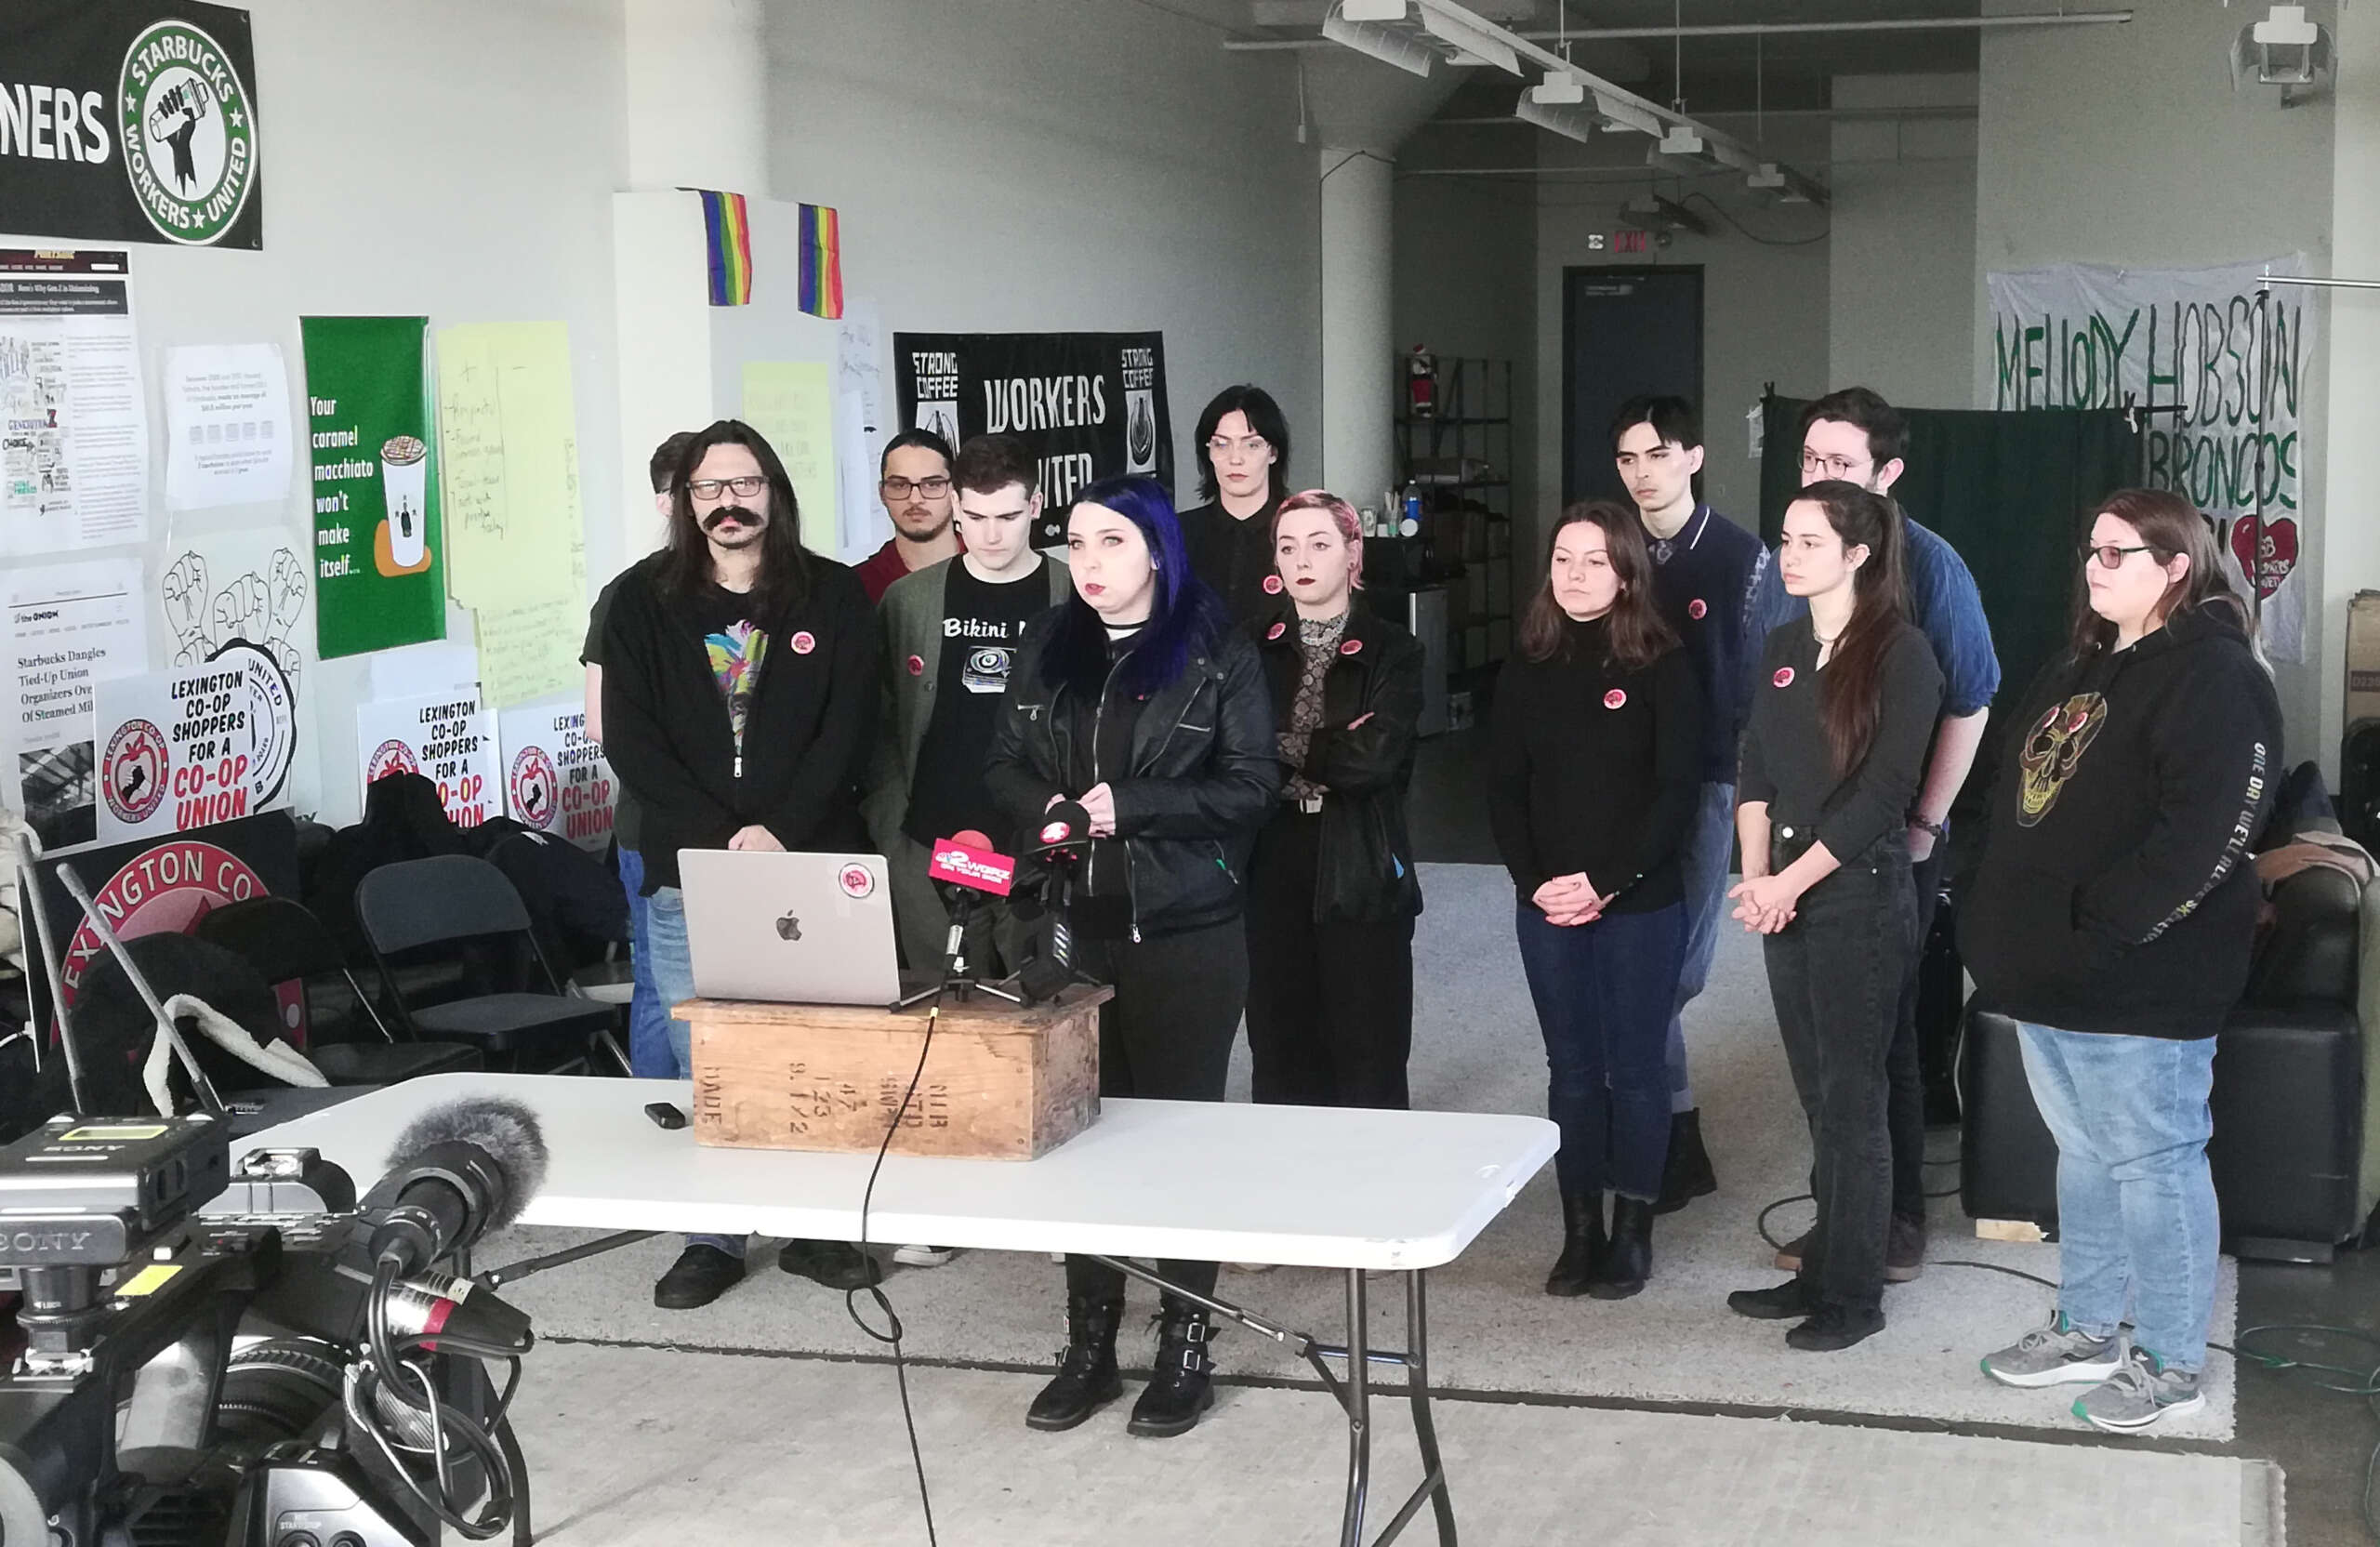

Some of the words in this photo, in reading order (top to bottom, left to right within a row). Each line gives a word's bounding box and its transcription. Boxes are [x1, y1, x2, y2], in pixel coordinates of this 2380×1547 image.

[132, 35, 233, 102] STARBUCKS
[0, 82, 110, 164] NERS
[126, 123, 190, 229] WORKERS
[205, 137, 245, 221] UNITED
[912, 352, 958, 375] STRONG
[1121, 348, 1153, 368] STRONG
[2148, 295, 2301, 429] HOBSON
[917, 377, 959, 399] COFFEE
[1122, 367, 1154, 389] COFFEE
[311, 397, 337, 416] Your
[984, 375, 1106, 434] WORKERS
[312, 425, 358, 449] caramel
[314, 456, 373, 482] macchiato
[1038, 453, 1092, 509] ITED
[2148, 430, 2297, 509] BRONCOS
[316, 491, 349, 513] won't
[319, 523, 350, 546] make
[33, 609, 59, 622] ONION
[942, 617, 1008, 639] Bikini
[18, 653, 66, 668] Starbucks
[68, 647, 106, 663] Dangles
[19, 672, 58, 688] Tied-Up
[60, 668, 89, 680] Union
[171, 670, 243, 699] LEXINGTON
[248, 658, 283, 707] UNITED
[20, 687, 73, 707] Organizers
[74, 684, 93, 697] Ove
[186, 693, 231, 718] CO-OP
[22, 710, 33, 723] Of
[35, 705, 76, 721] Steamed
[78, 699, 93, 714] Mil
[419, 700, 475, 723] LEXINGTON
[553, 713, 586, 732] LEXING
[173, 711, 245, 742] SHOPPERS
[431, 720, 466, 740] CO-OP
[564, 730, 592, 747] CO-O
[189, 741, 215, 762] FOR
[221, 737, 231, 755] A
[422, 735, 478, 761] SHOPPERS
[557, 745, 606, 767] SHOPPERS
[2253, 743, 2266, 776] ONE
[174, 754, 248, 798] CO-OP
[436, 760, 456, 780] FOR
[461, 759, 468, 774] A
[570, 767, 588, 785] FOR
[591, 764, 599, 780] A
[438, 774, 483, 808] O-OP
[562, 780, 610, 813] CO-OP
[2244, 776, 2264, 811] DAY
[177, 787, 248, 832] UNION
[448, 804, 483, 828] ION
[567, 806, 613, 840] UNION
[2226, 811, 2254, 854] WE'LL
[948, 851, 970, 867] 2
[2210, 855, 2232, 879] ALL
[64, 850, 202, 989] EXNGTON
[218, 861, 252, 902] CO
